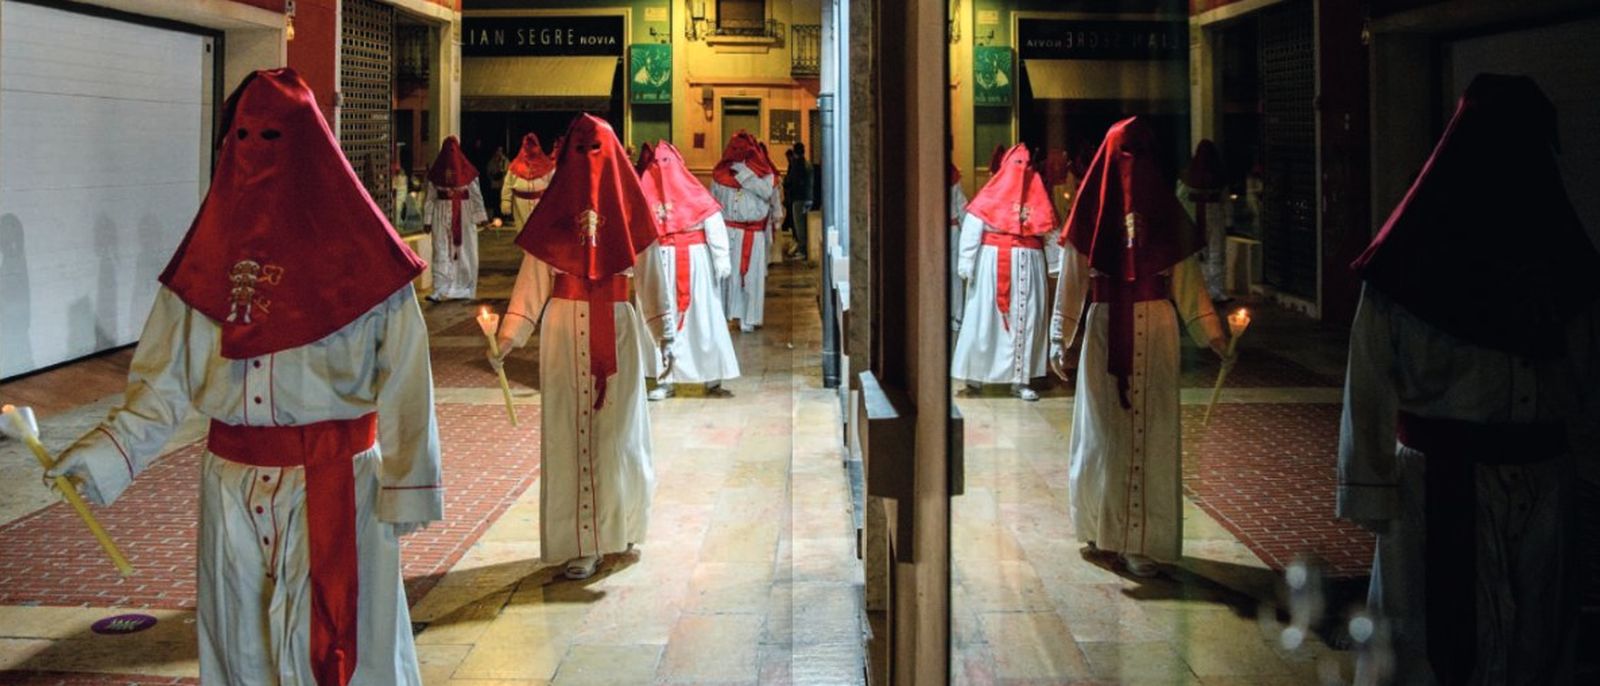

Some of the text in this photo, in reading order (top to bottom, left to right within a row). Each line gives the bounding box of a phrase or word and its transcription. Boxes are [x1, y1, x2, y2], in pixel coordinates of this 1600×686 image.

[461, 28, 616, 46] IAN SEGRE NOVIA
